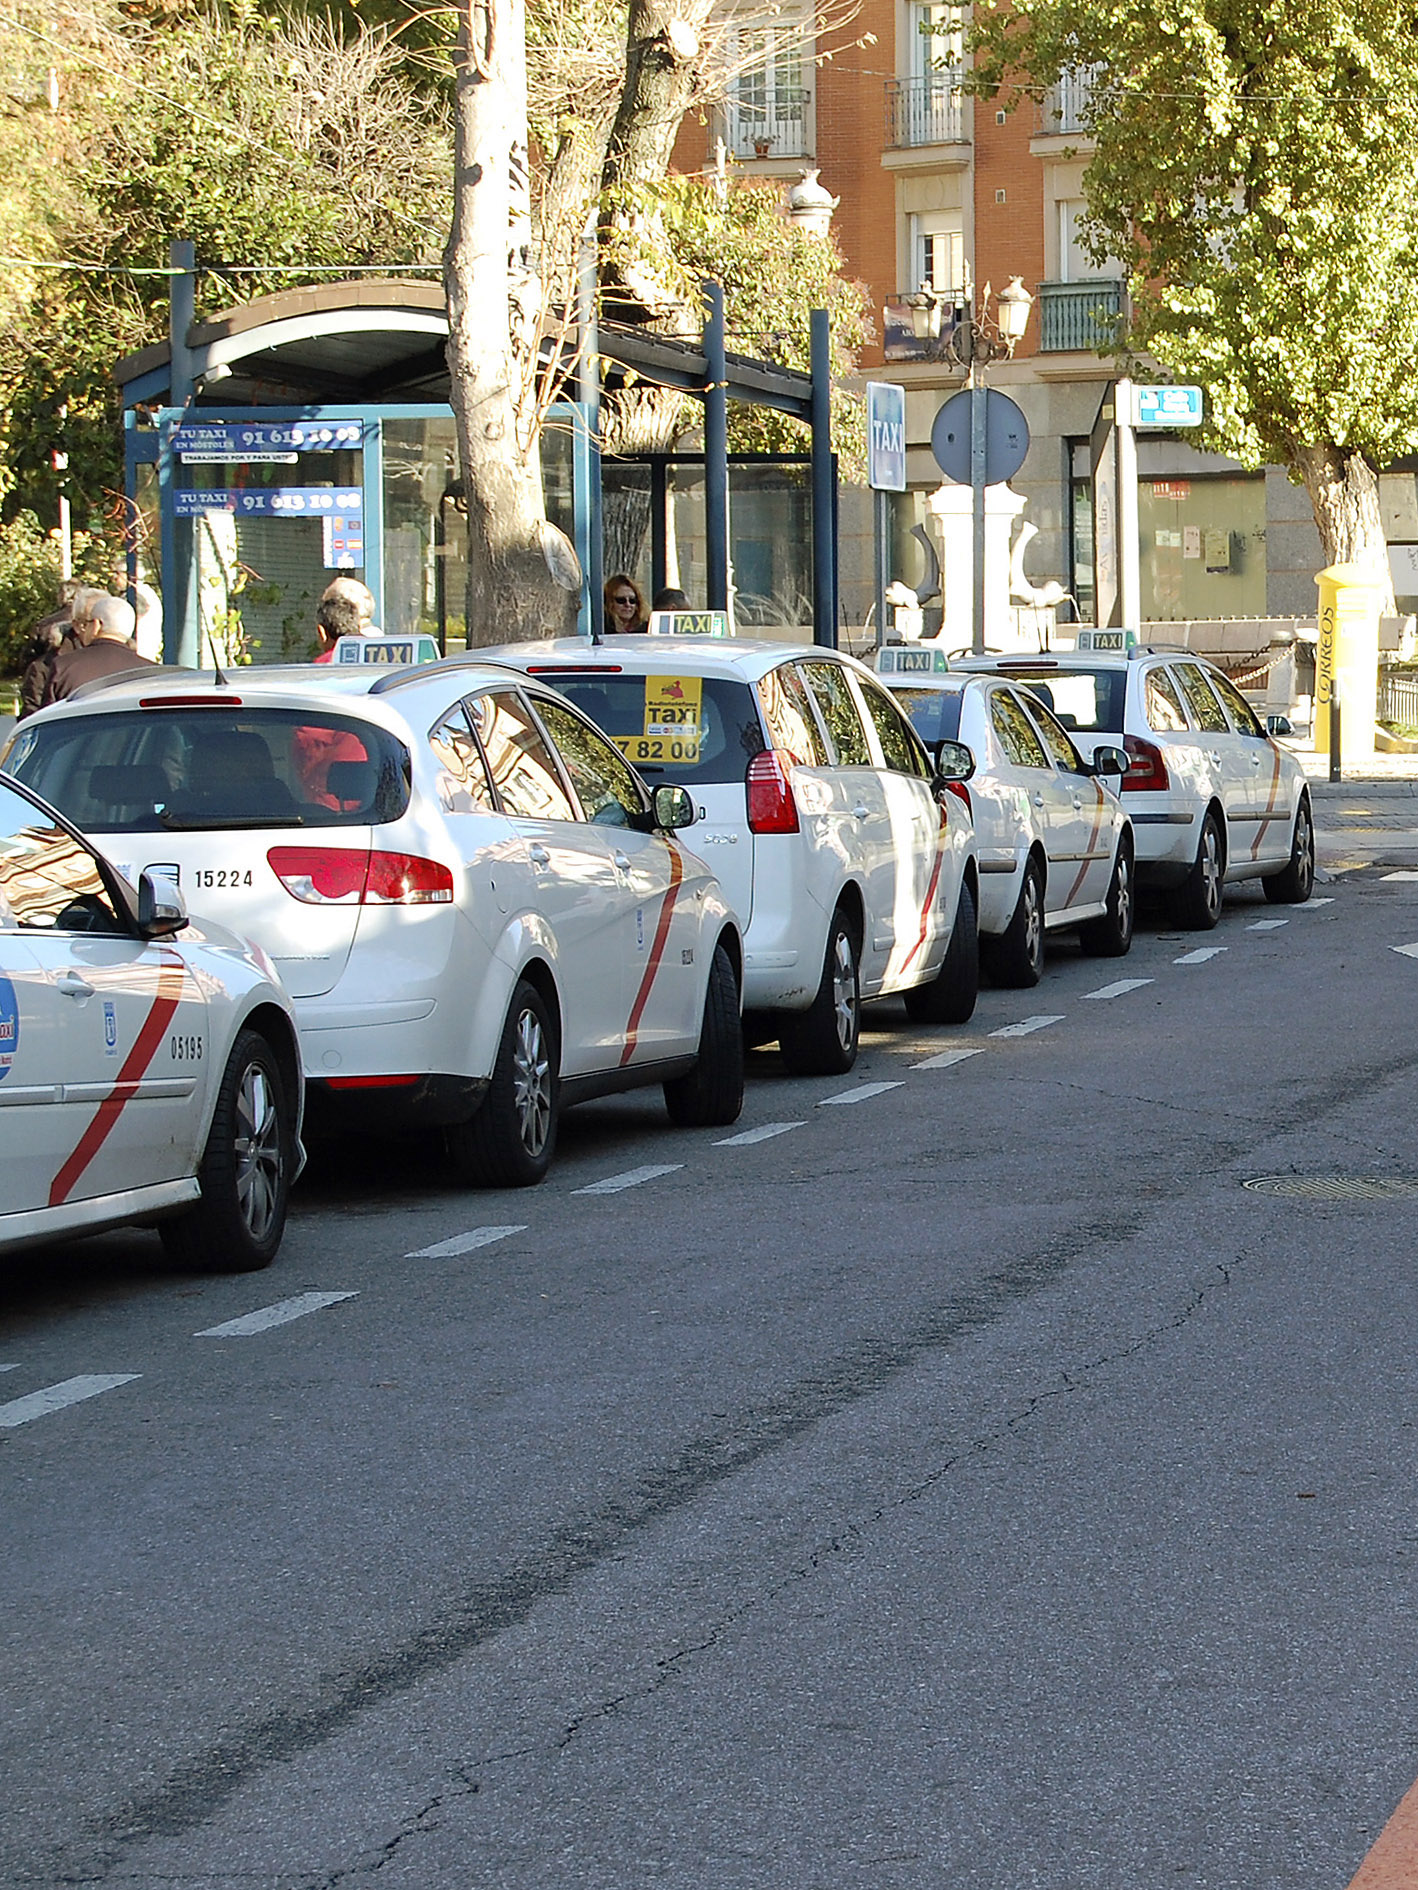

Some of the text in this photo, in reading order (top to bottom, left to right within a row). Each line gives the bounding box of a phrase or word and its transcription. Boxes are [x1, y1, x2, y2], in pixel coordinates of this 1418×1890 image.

[180, 429, 227, 439] TU TAXI
[242, 430, 265, 447] 91
[270, 429, 305, 446] 613
[872, 419, 904, 454] TAXI
[175, 440, 189, 449] EN
[180, 493, 228, 503] TU TAXI
[243, 496, 265, 510] 91
[270, 494, 306, 510] 613
[175, 505, 189, 513] EN
[674, 615, 711, 633] TAXI
[1094, 634, 1122, 648] TAXI
[365, 645, 412, 664] TAXI
[898, 653, 929, 670] TAXI
[1317, 606, 1335, 704] CORREOS
[637, 741, 663, 759] 82
[671, 741, 697, 760] 00
[195, 870, 253, 888] 15224
[171, 1035, 203, 1060] 05195
